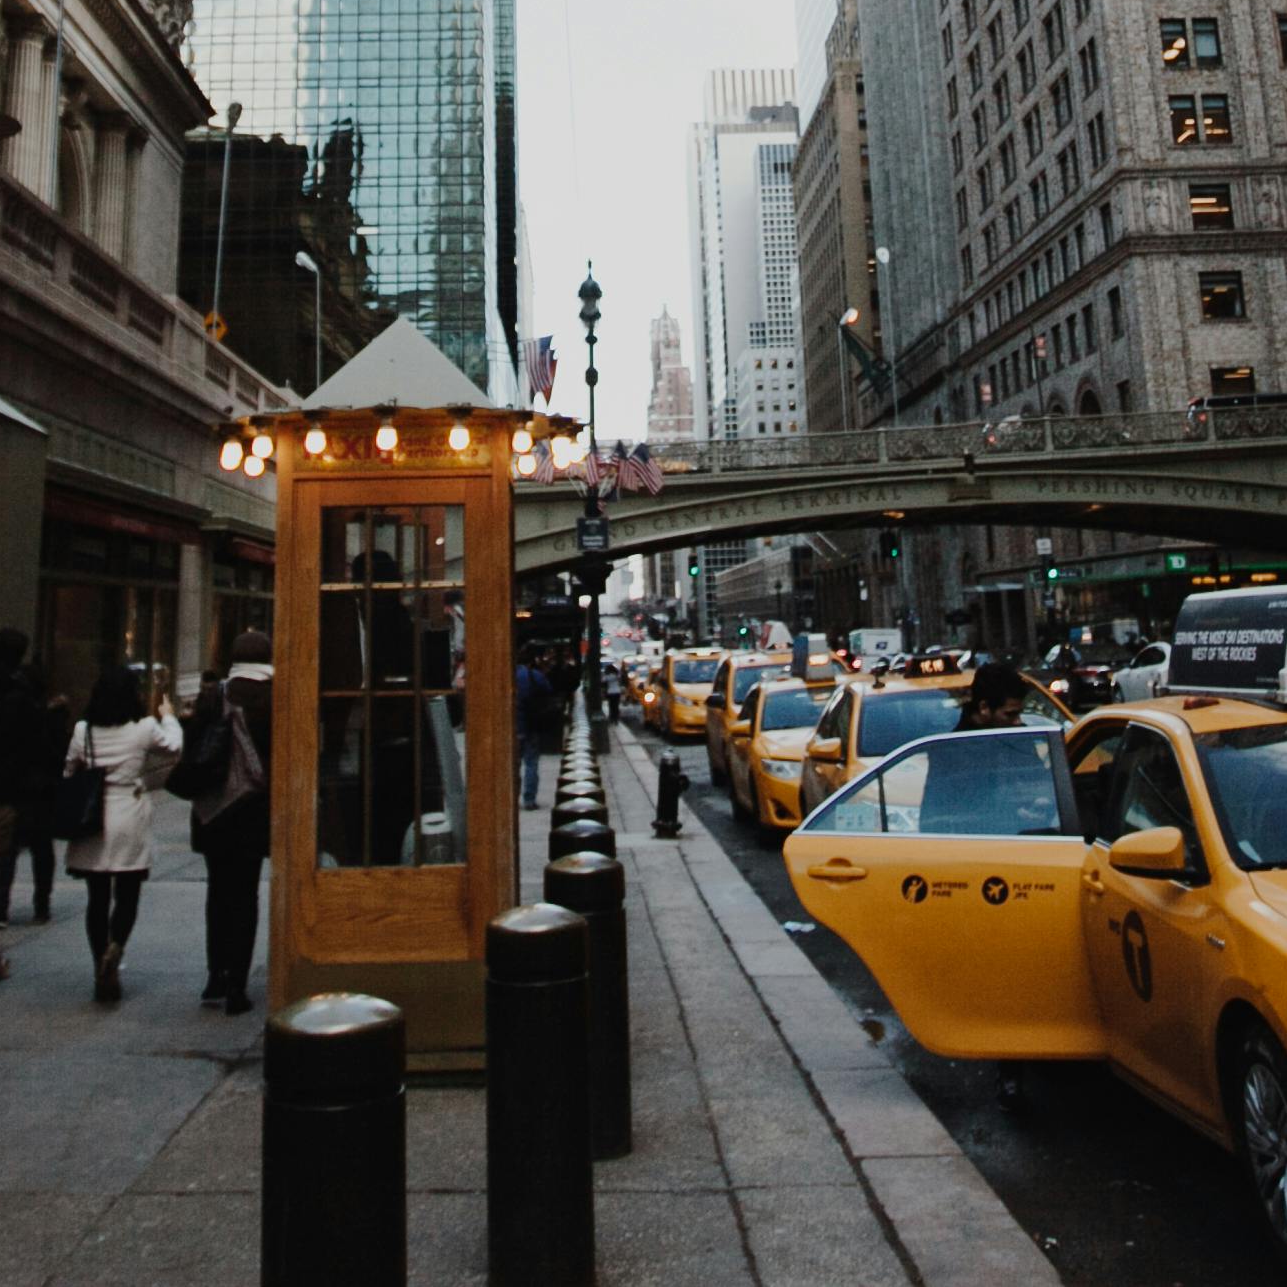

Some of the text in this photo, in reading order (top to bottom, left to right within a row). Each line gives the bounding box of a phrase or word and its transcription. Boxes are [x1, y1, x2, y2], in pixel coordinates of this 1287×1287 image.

[1037, 478, 1156, 496] PERSHING
[1172, 482, 1261, 503] SQUARE
[554, 523, 636, 551] GND
[653, 502, 762, 531] CENTRAL
[777, 486, 901, 512] TERMINAL
[1174, 631, 1197, 645] SERVING
[1198, 631, 1209, 644] THE
[1209, 630, 1226, 644] MOST
[1237, 629, 1285, 644] DESTINATIONS
[1191, 647, 1208, 660] WEST
[1217, 647, 1229, 660] THE
[1229, 646, 1257, 661] ROCKIES
[931, 890, 952, 898] FARE
[1012, 883, 1055, 892] FLAT FARE
